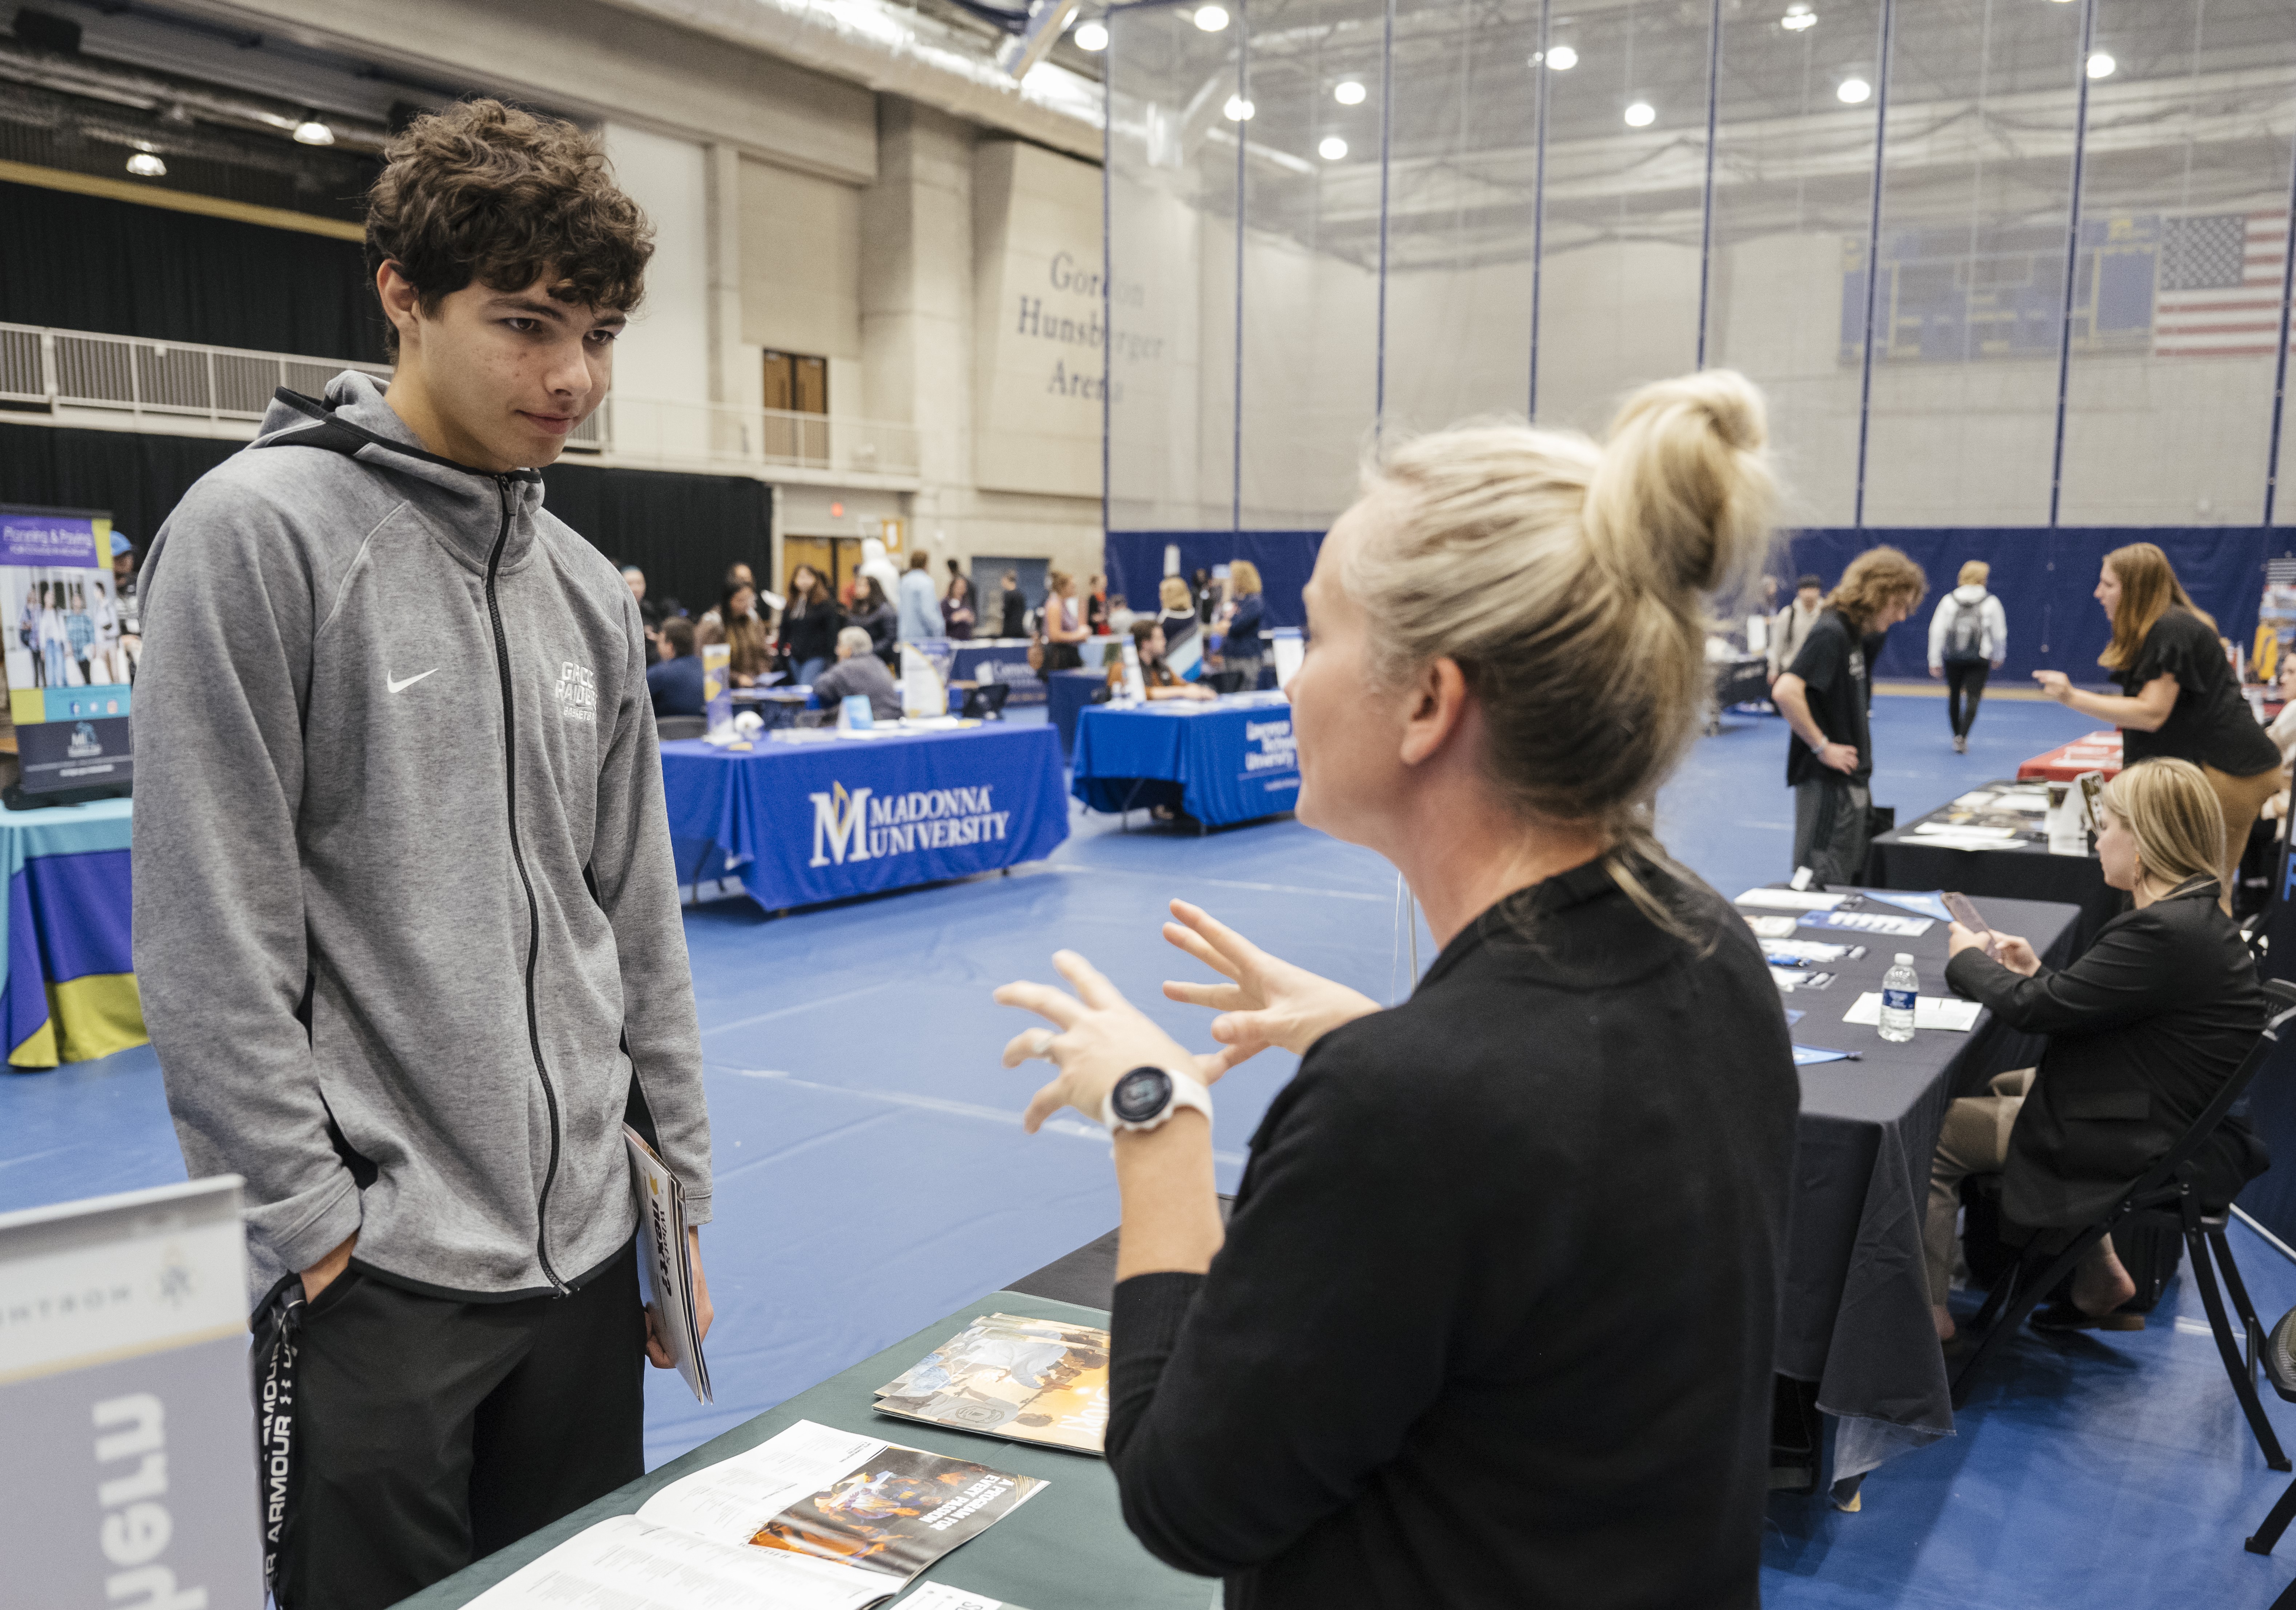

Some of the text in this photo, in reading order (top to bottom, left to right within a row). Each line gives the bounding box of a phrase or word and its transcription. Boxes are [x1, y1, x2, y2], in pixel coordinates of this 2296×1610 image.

[1050, 251, 1144, 308] Goron
[1017, 295, 1165, 364] Hunsbrger
[870, 786, 991, 827] MADONNA
[870, 811, 1010, 858] UNIVERSITY
[651, 1198, 672, 1297] next?
[659, 1210, 671, 1266] What's
[268, 1415, 292, 1543] ARMOUR
[918, 1474, 1000, 1523] EVERY PASSION
[929, 1478, 1014, 1530] A PROGRAM FOR
